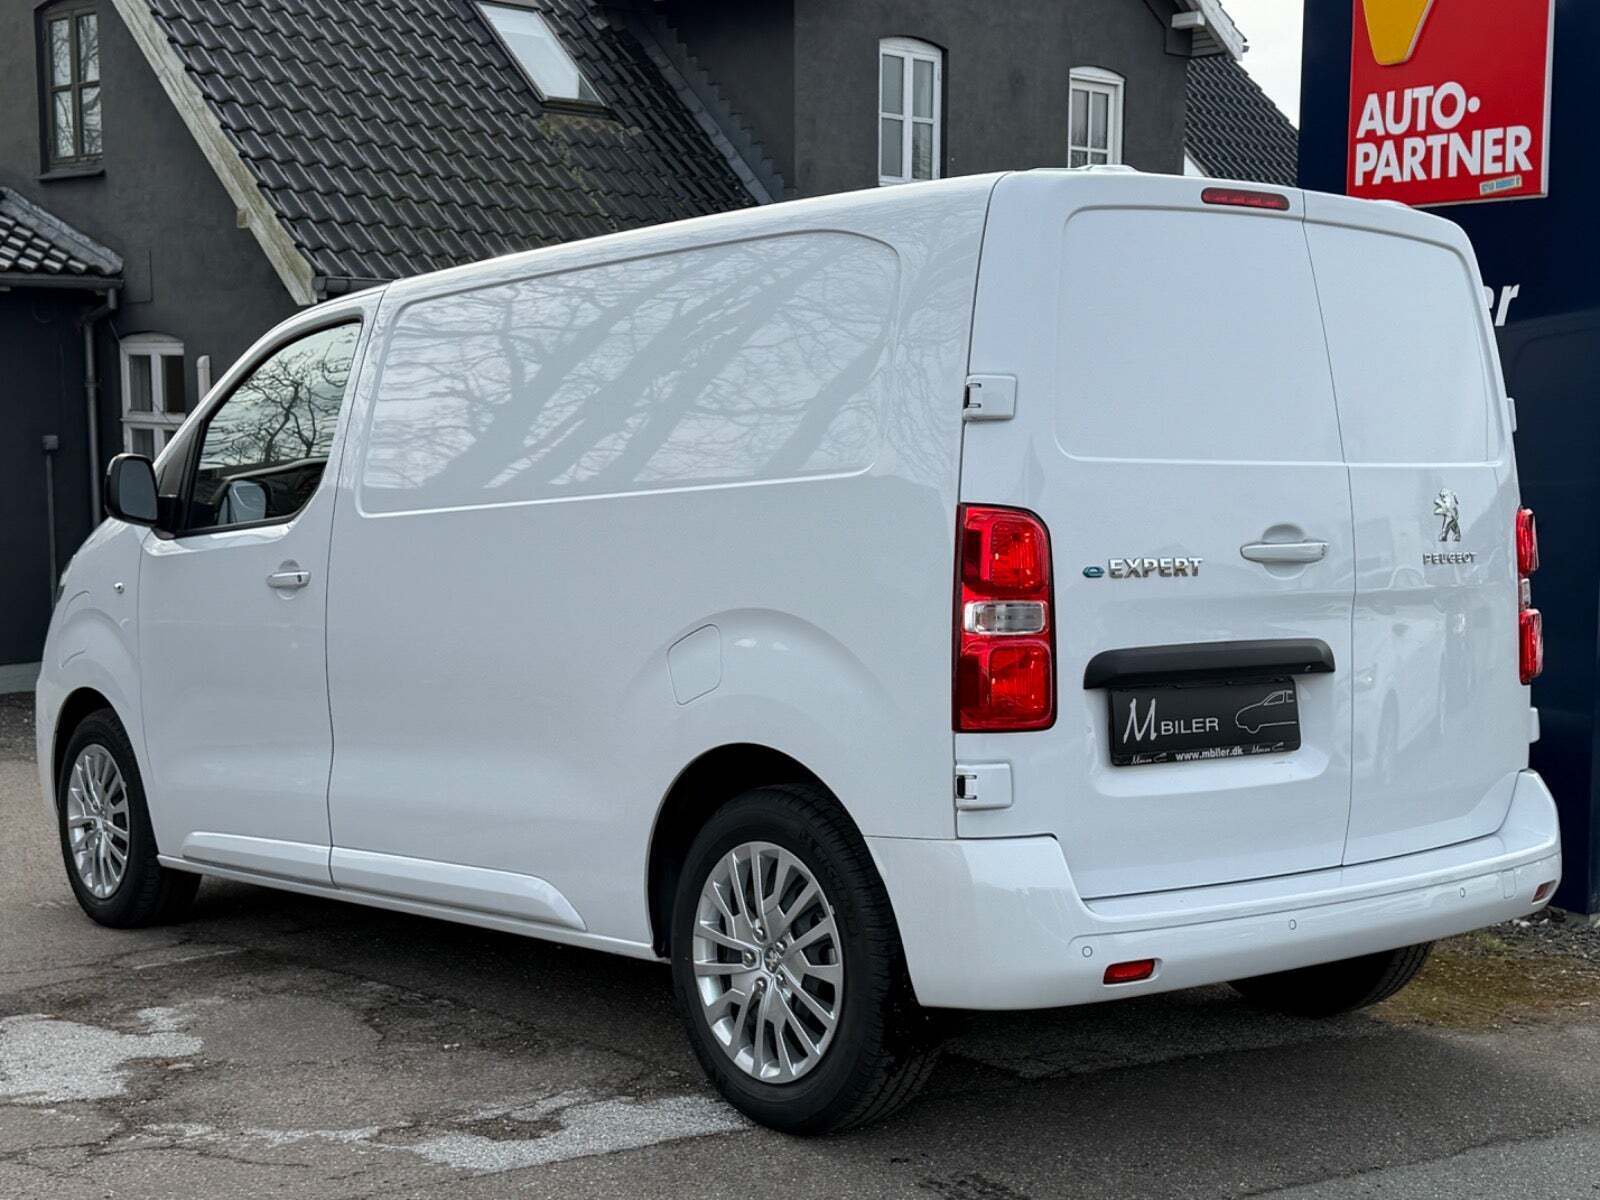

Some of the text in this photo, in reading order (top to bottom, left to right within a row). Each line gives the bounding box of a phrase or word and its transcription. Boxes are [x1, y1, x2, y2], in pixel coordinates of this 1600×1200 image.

[1354, 125, 1533, 186] PARTNER
[1108, 557, 1203, 579] EXPERT
[1423, 552, 1477, 566] PEUGEOT
[1175, 746, 1243, 761] www.mbiler.dk
